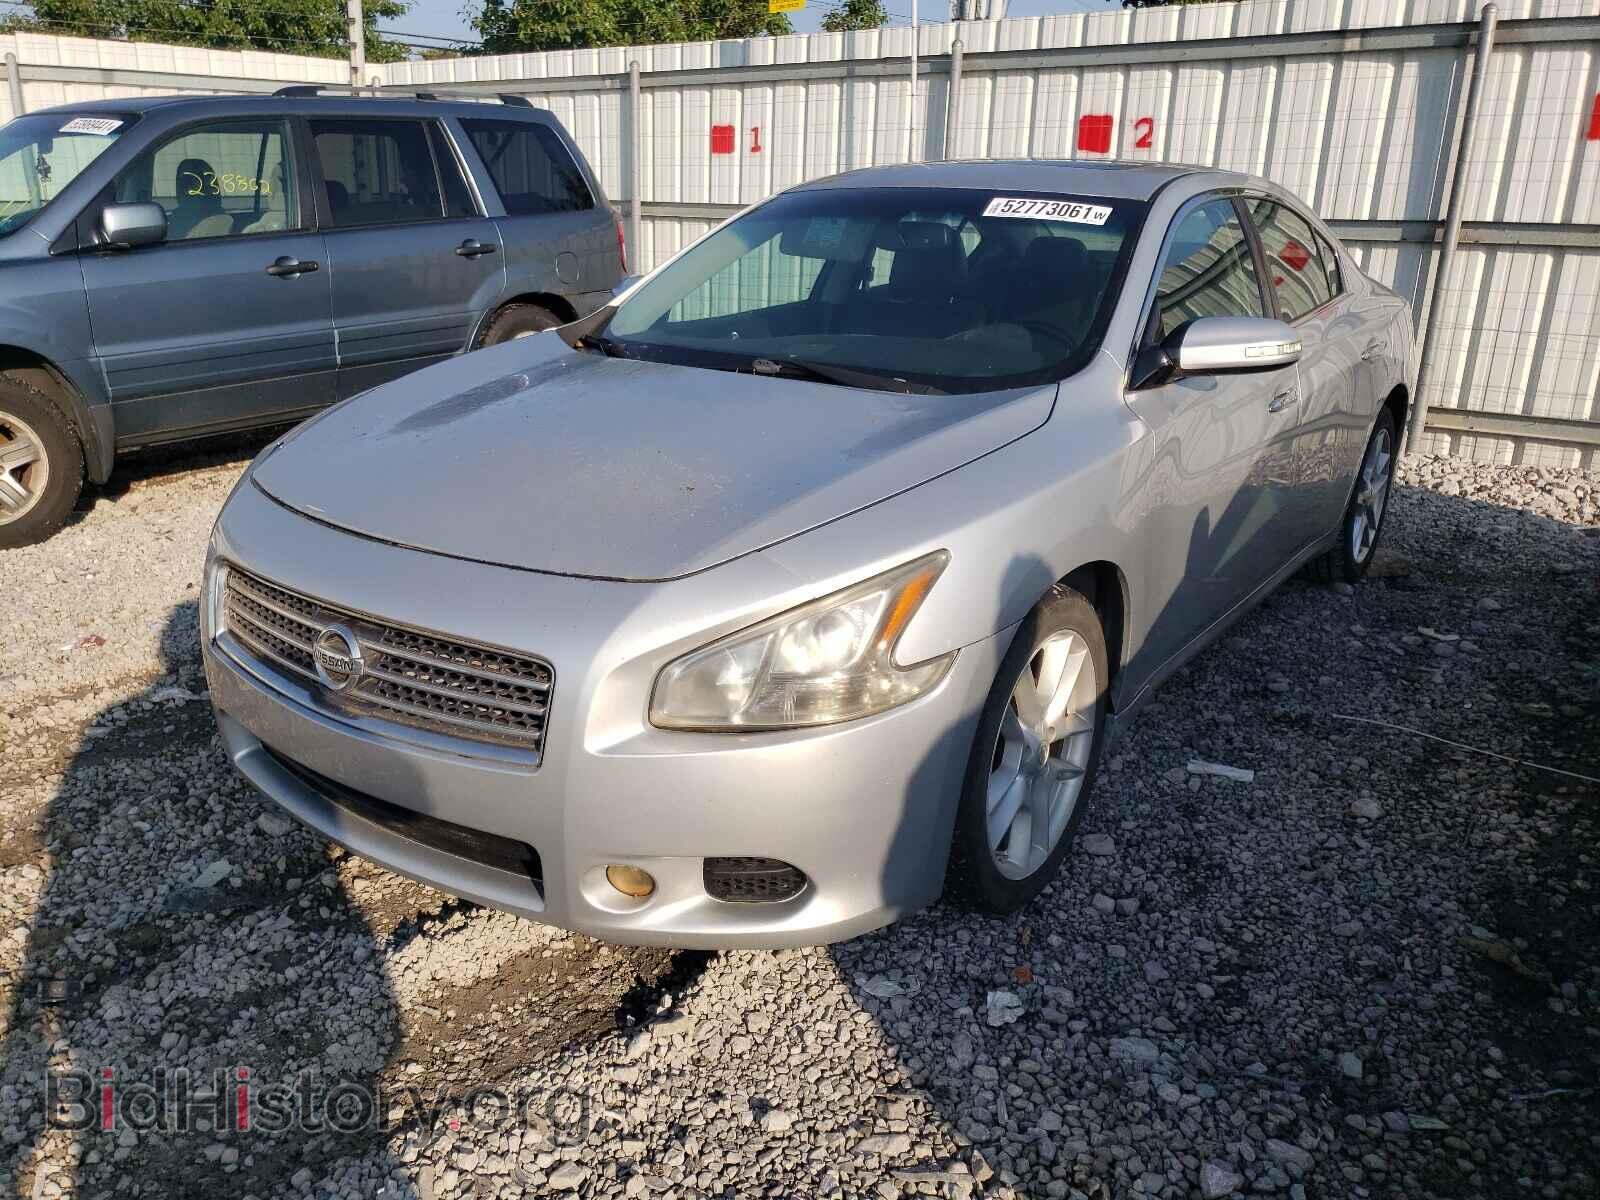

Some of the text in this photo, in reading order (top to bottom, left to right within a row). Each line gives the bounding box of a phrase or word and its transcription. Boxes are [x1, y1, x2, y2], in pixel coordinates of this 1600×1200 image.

[750, 126, 763, 153] 1
[1134, 116, 1153, 149] 2
[1001, 199, 1093, 220] 52773061
[313, 647, 353, 672] NISSAN
